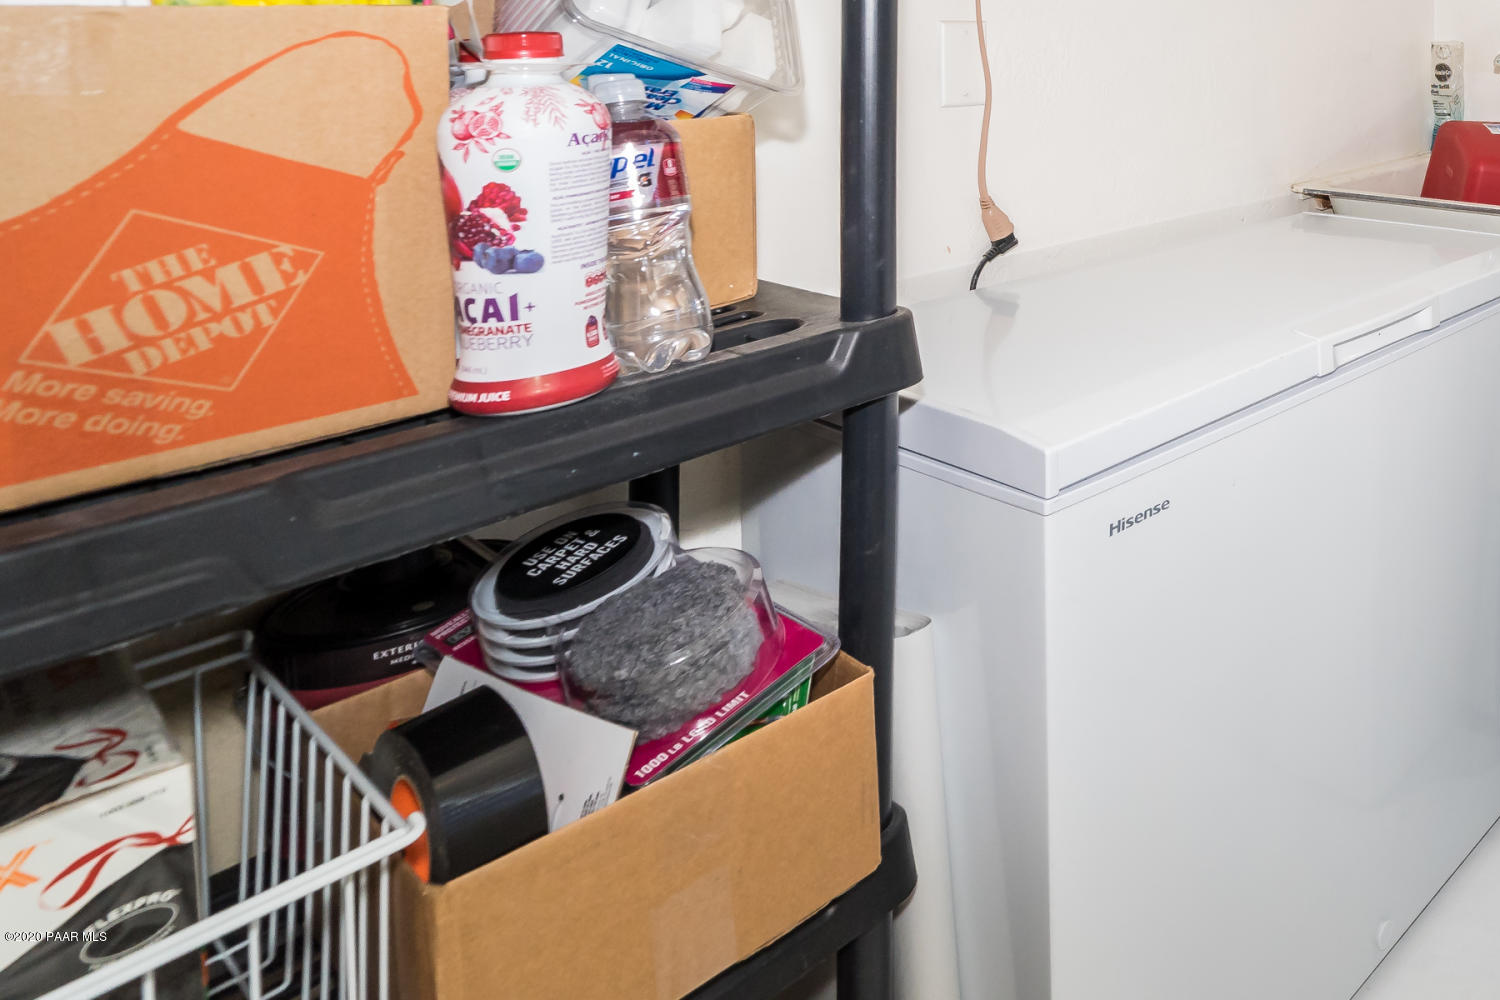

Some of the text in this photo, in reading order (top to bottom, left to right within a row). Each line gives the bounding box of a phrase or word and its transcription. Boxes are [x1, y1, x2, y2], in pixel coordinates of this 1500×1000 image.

[110, 244, 217, 294] THE
[46, 244, 306, 367] HOME
[122, 300, 279, 376] DEPOT
[2, 370, 216, 421] More saving.
[83, 414, 184, 445] doing.
[1109, 499, 1170, 537] Hisense
[522, 530, 579, 567] USE ON
[526, 529, 601, 577] CARPET &
[552, 534, 628, 586] SURFACES
[555, 542, 599, 570] HARD
[373, 640, 424, 661] EXTERI
[634, 752, 669, 779] 1000
[667, 742, 683, 755] LB
[714, 690, 750, 718] LIMIT
